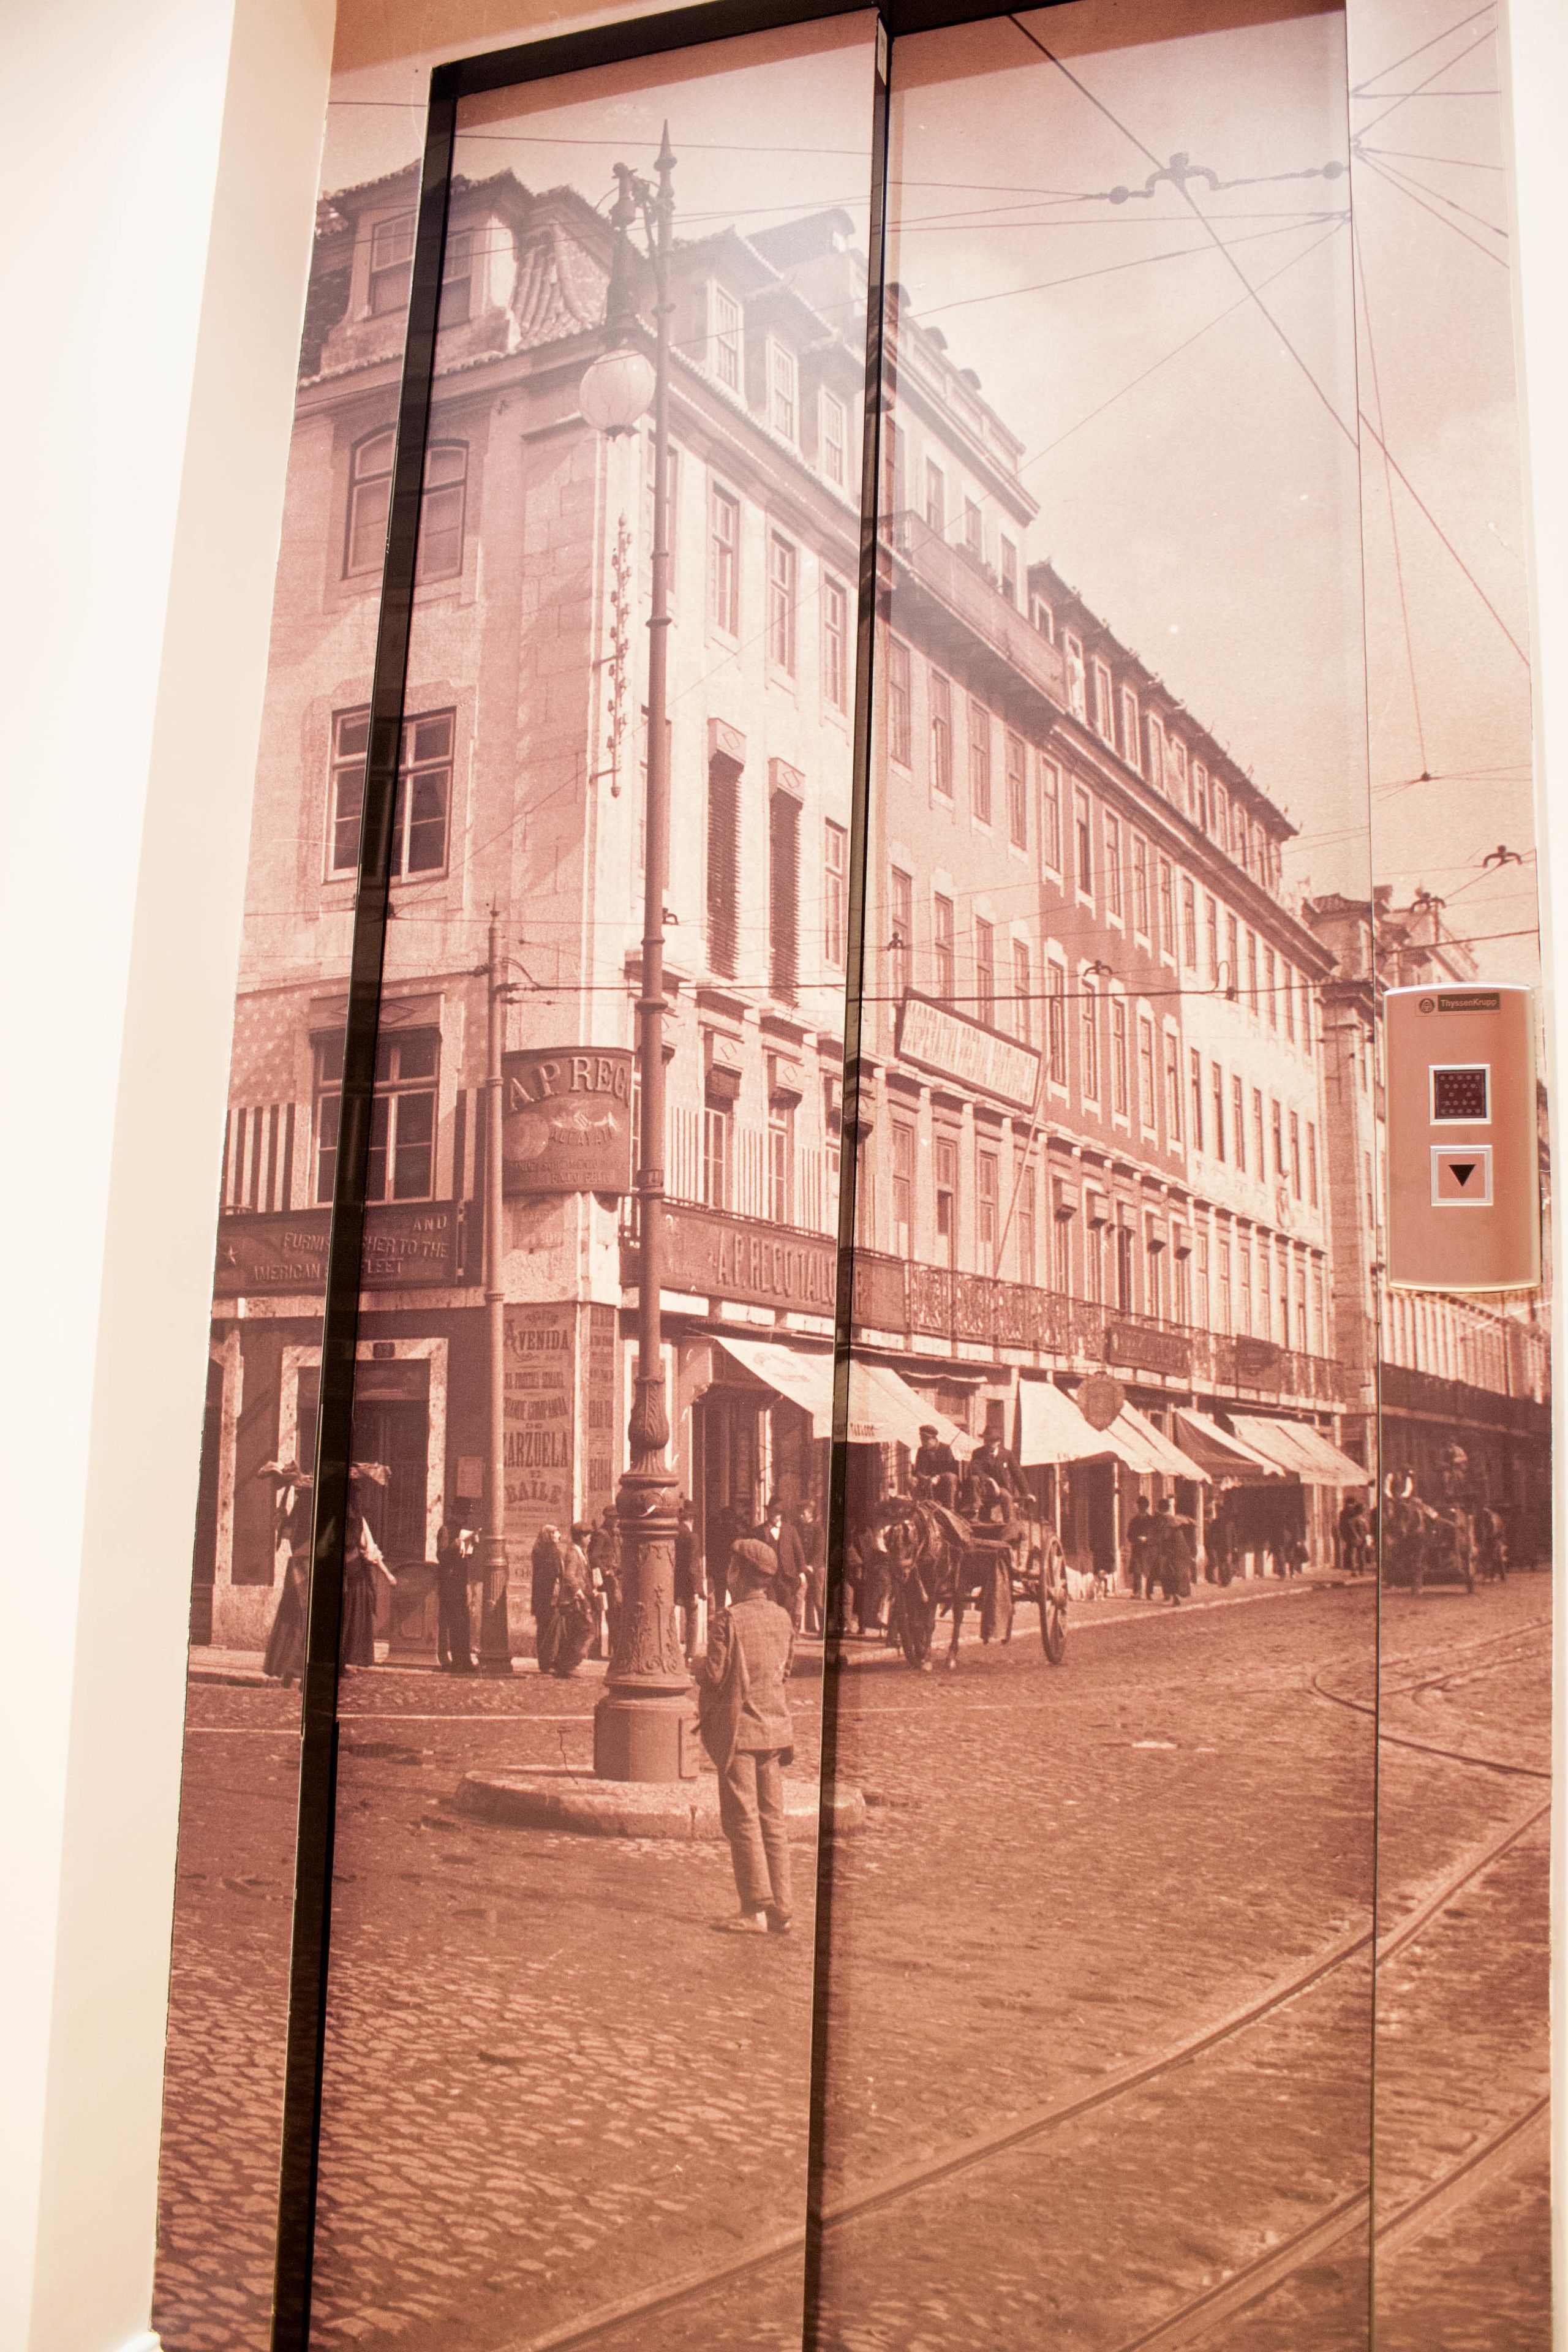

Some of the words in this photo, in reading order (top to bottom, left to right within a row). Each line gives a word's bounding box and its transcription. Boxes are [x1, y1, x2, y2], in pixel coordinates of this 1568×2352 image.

[1440, 998, 1497, 1008] ThyssenKrupp
[412, 1213, 448, 1231] AND
[399, 1237, 418, 1255] TO
[422, 1240, 450, 1259] THE
